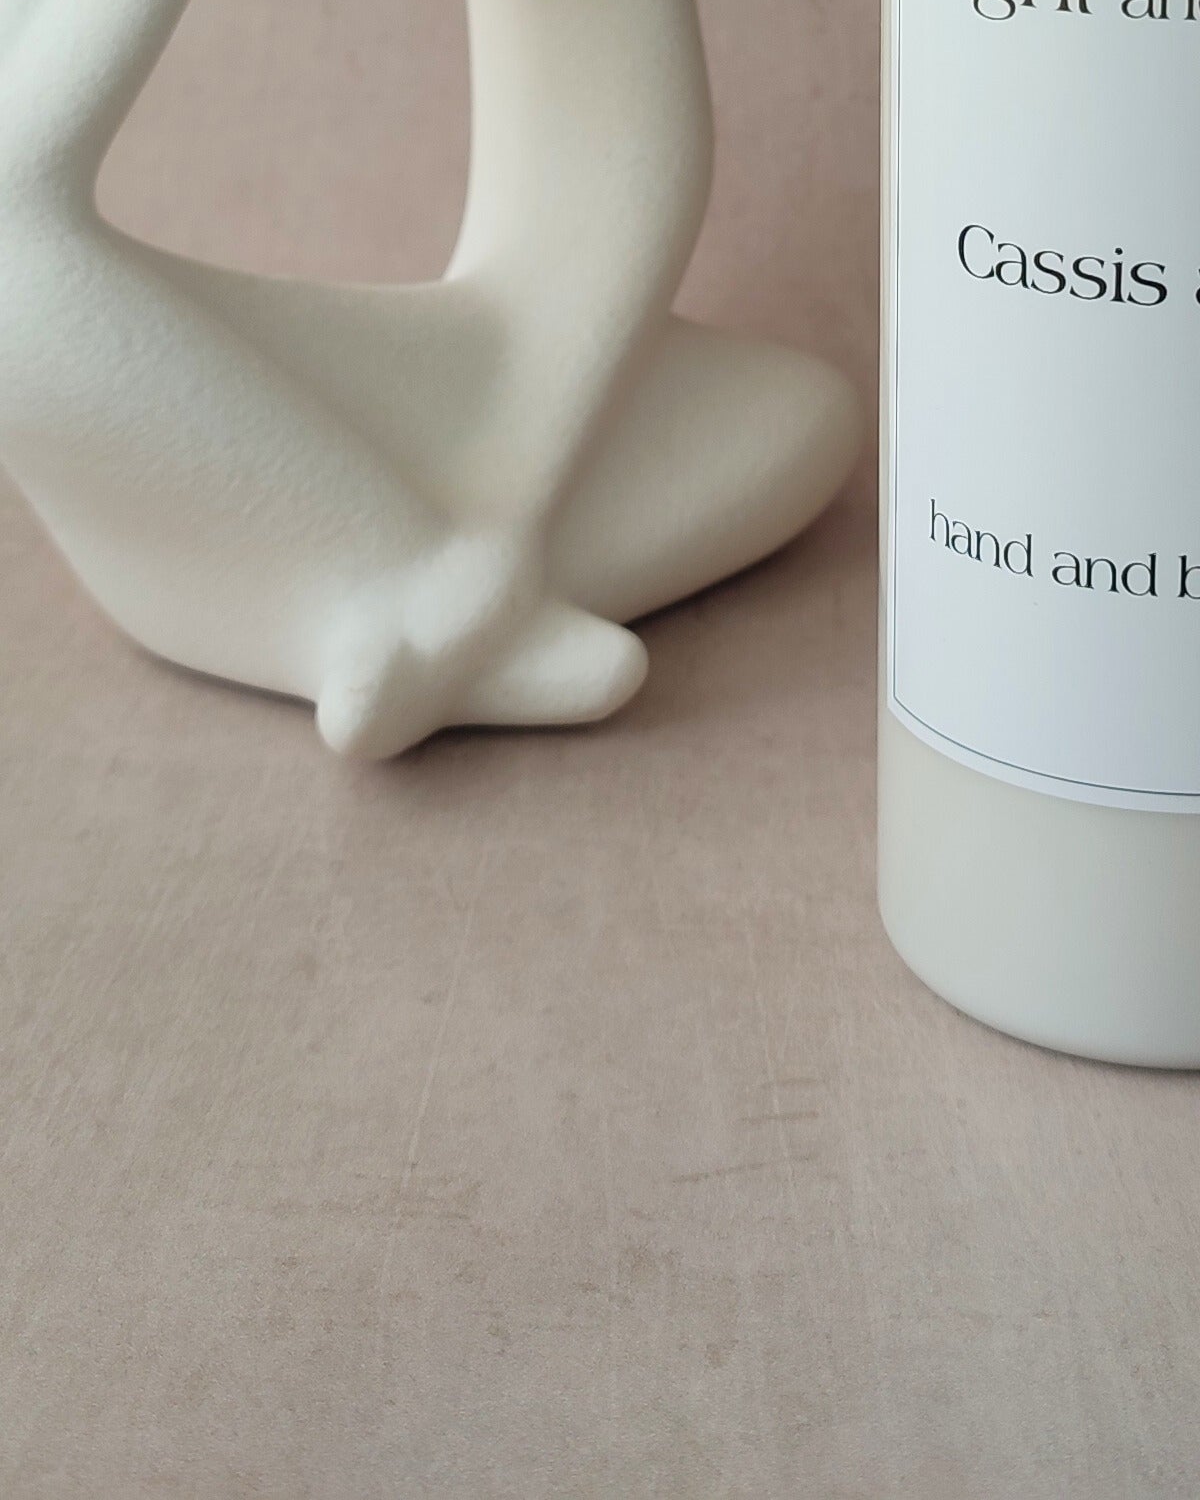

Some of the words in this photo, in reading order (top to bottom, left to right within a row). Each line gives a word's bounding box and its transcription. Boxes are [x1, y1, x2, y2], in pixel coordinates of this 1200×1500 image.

[957, 224, 1168, 307] Cassis
[929, 499, 1034, 578] hand
[1052, 552, 1159, 598] and
